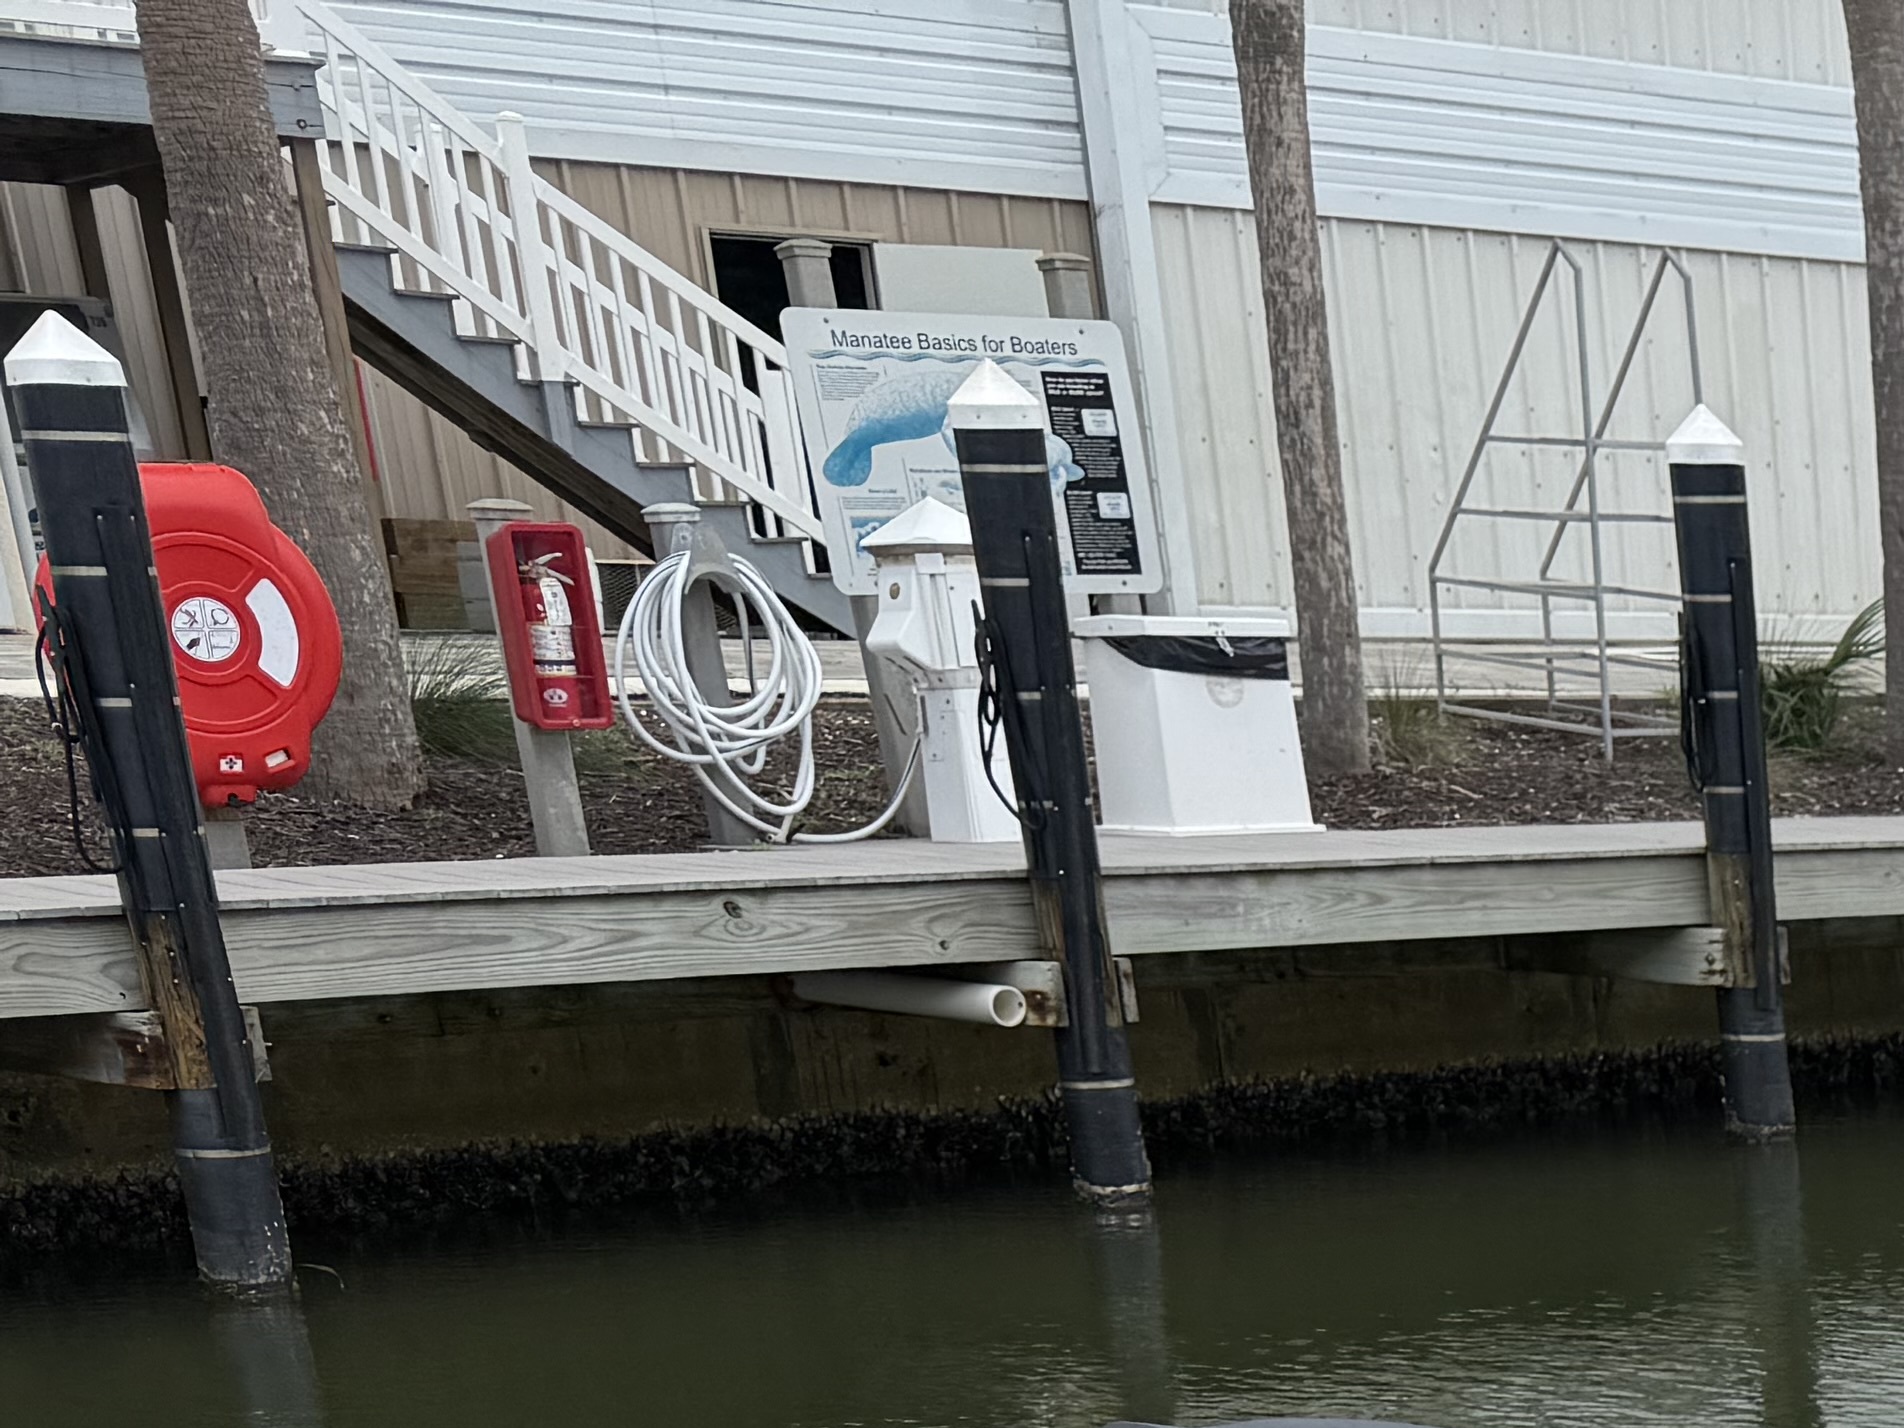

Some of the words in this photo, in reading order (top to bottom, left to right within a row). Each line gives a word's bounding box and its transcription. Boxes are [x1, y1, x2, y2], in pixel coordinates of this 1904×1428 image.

[830, 329, 913, 350] Manatee
[916, 332, 978, 352] Basics
[981, 334, 1005, 353] for
[1009, 335, 1079, 356] Boaters
